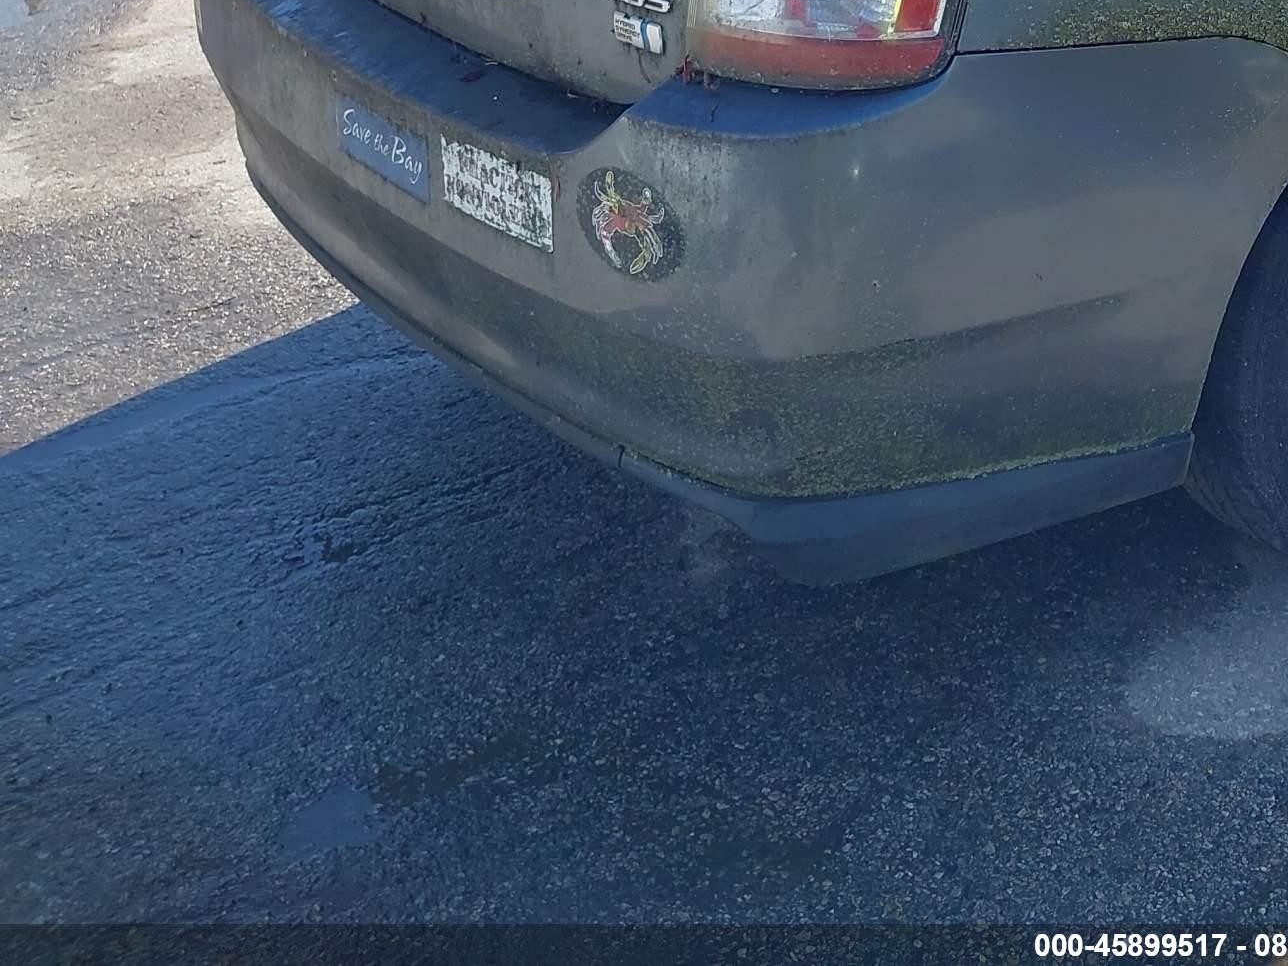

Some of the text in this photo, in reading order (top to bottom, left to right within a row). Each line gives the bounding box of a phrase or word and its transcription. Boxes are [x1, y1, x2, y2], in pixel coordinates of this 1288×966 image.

[343, 108, 422, 185] Save the Bay
